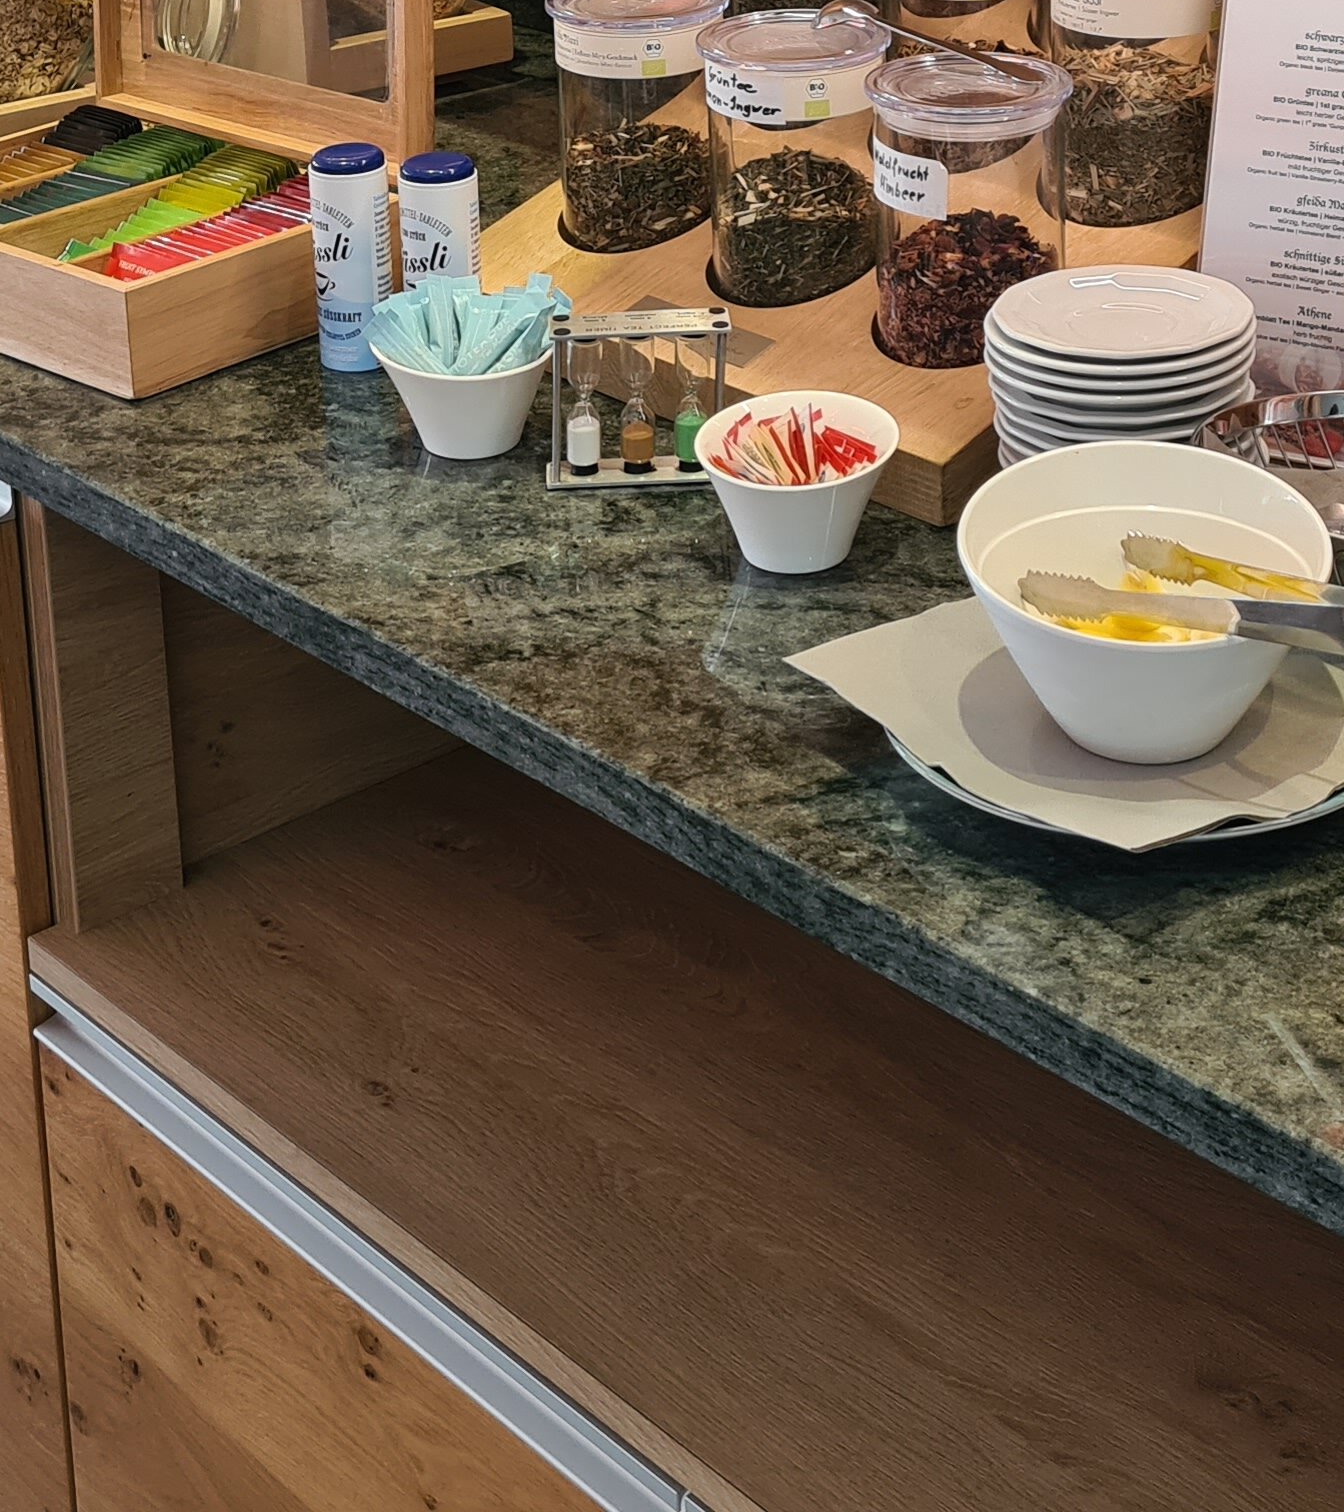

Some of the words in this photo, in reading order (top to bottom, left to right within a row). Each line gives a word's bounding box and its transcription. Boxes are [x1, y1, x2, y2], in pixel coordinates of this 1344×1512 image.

[646, 43, 661, 51] BIO
[1295, 43, 1309, 51] BIO
[809, 83, 825, 91] BIO
[1273, 96, 1287, 104] BIO
[1262, 149, 1276, 157] BIO
[880, 172, 926, 203] Himbeer
[1269, 205, 1283, 213] BIO
[1269, 260, 1284, 269] BIO
[1297, 306, 1332, 320] Athene
